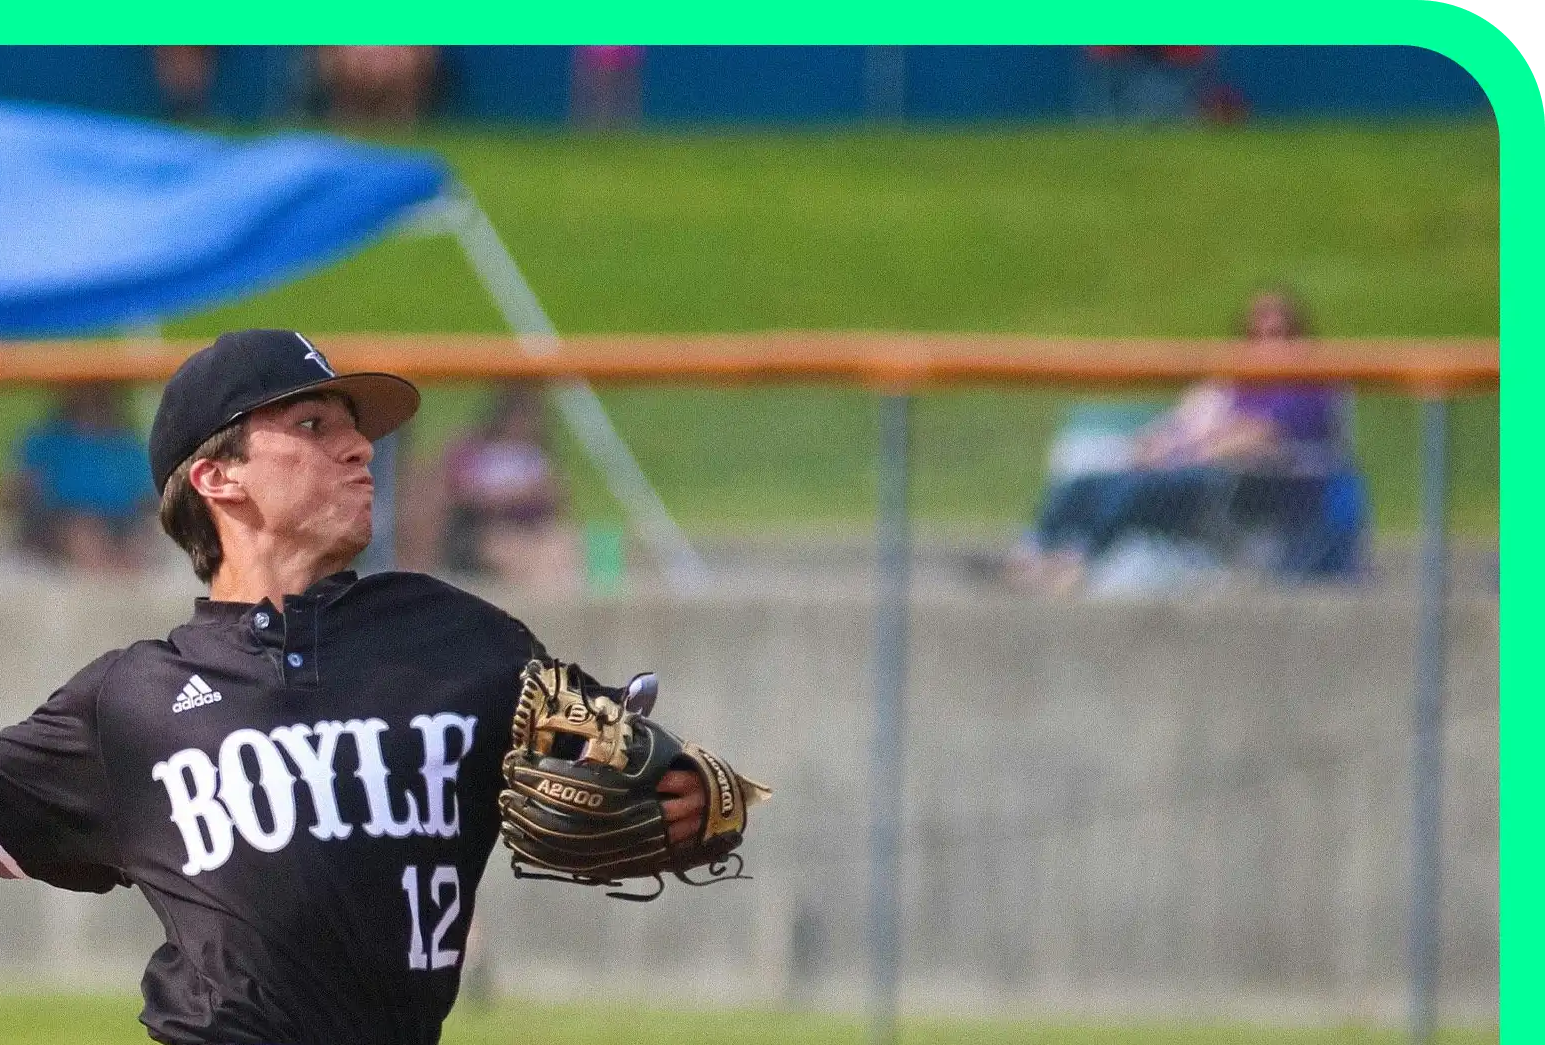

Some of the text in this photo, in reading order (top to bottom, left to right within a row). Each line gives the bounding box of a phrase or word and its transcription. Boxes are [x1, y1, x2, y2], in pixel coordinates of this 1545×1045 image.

[172, 691, 222, 713] adidas
[152, 711, 478, 876] BOYLE
[536, 779, 604, 807] A2000
[401, 865, 461, 971] 12
